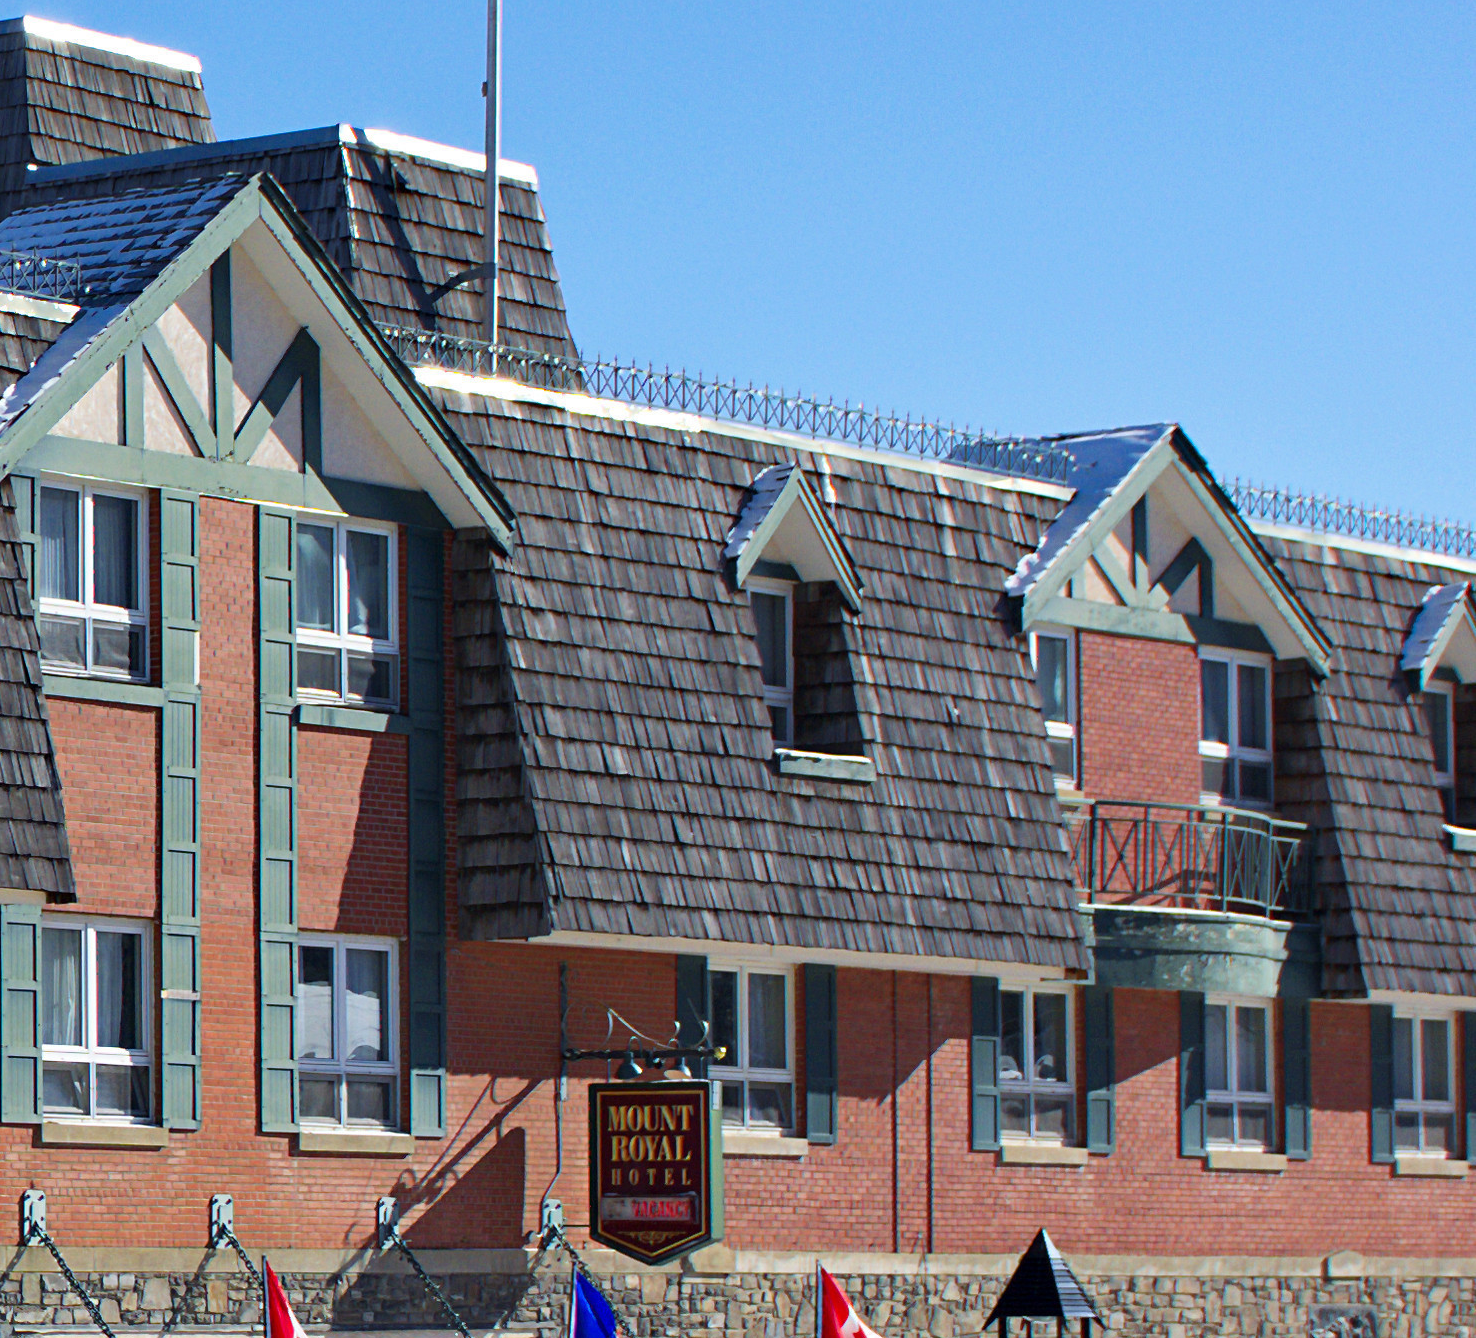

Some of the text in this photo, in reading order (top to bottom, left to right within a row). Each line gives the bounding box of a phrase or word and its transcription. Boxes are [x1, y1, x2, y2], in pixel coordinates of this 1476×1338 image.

[608, 1104, 694, 1132] MOUNT
[611, 1134, 693, 1162] ROYAL
[611, 1168, 693, 1186] HOTEL
[632, 1200, 691, 1219] VACANCY
